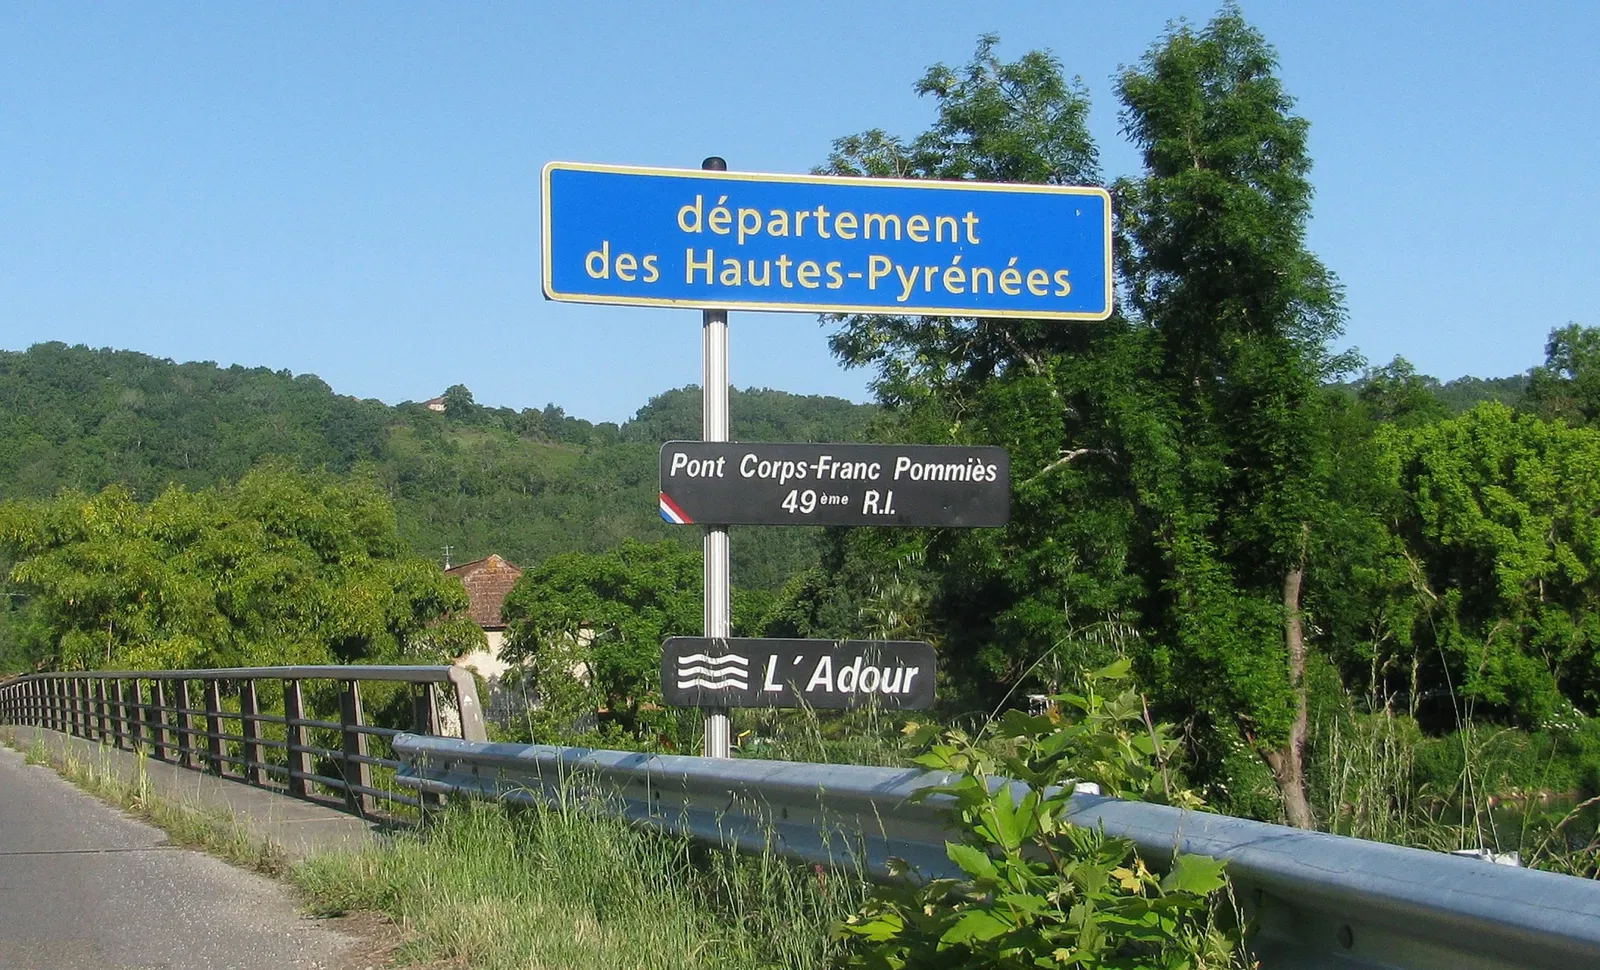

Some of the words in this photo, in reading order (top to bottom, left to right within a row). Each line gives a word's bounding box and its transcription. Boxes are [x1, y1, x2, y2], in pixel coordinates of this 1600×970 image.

[677, 194, 980, 245] département
[585, 241, 660, 284] des
[685, 248, 1072, 302] Hautes-Pyrénées
[670, 452, 725, 479] Pont
[739, 454, 881, 486] Corps-Franc
[893, 456, 998, 483] Pommiès
[862, 490, 896, 515] R.I.
